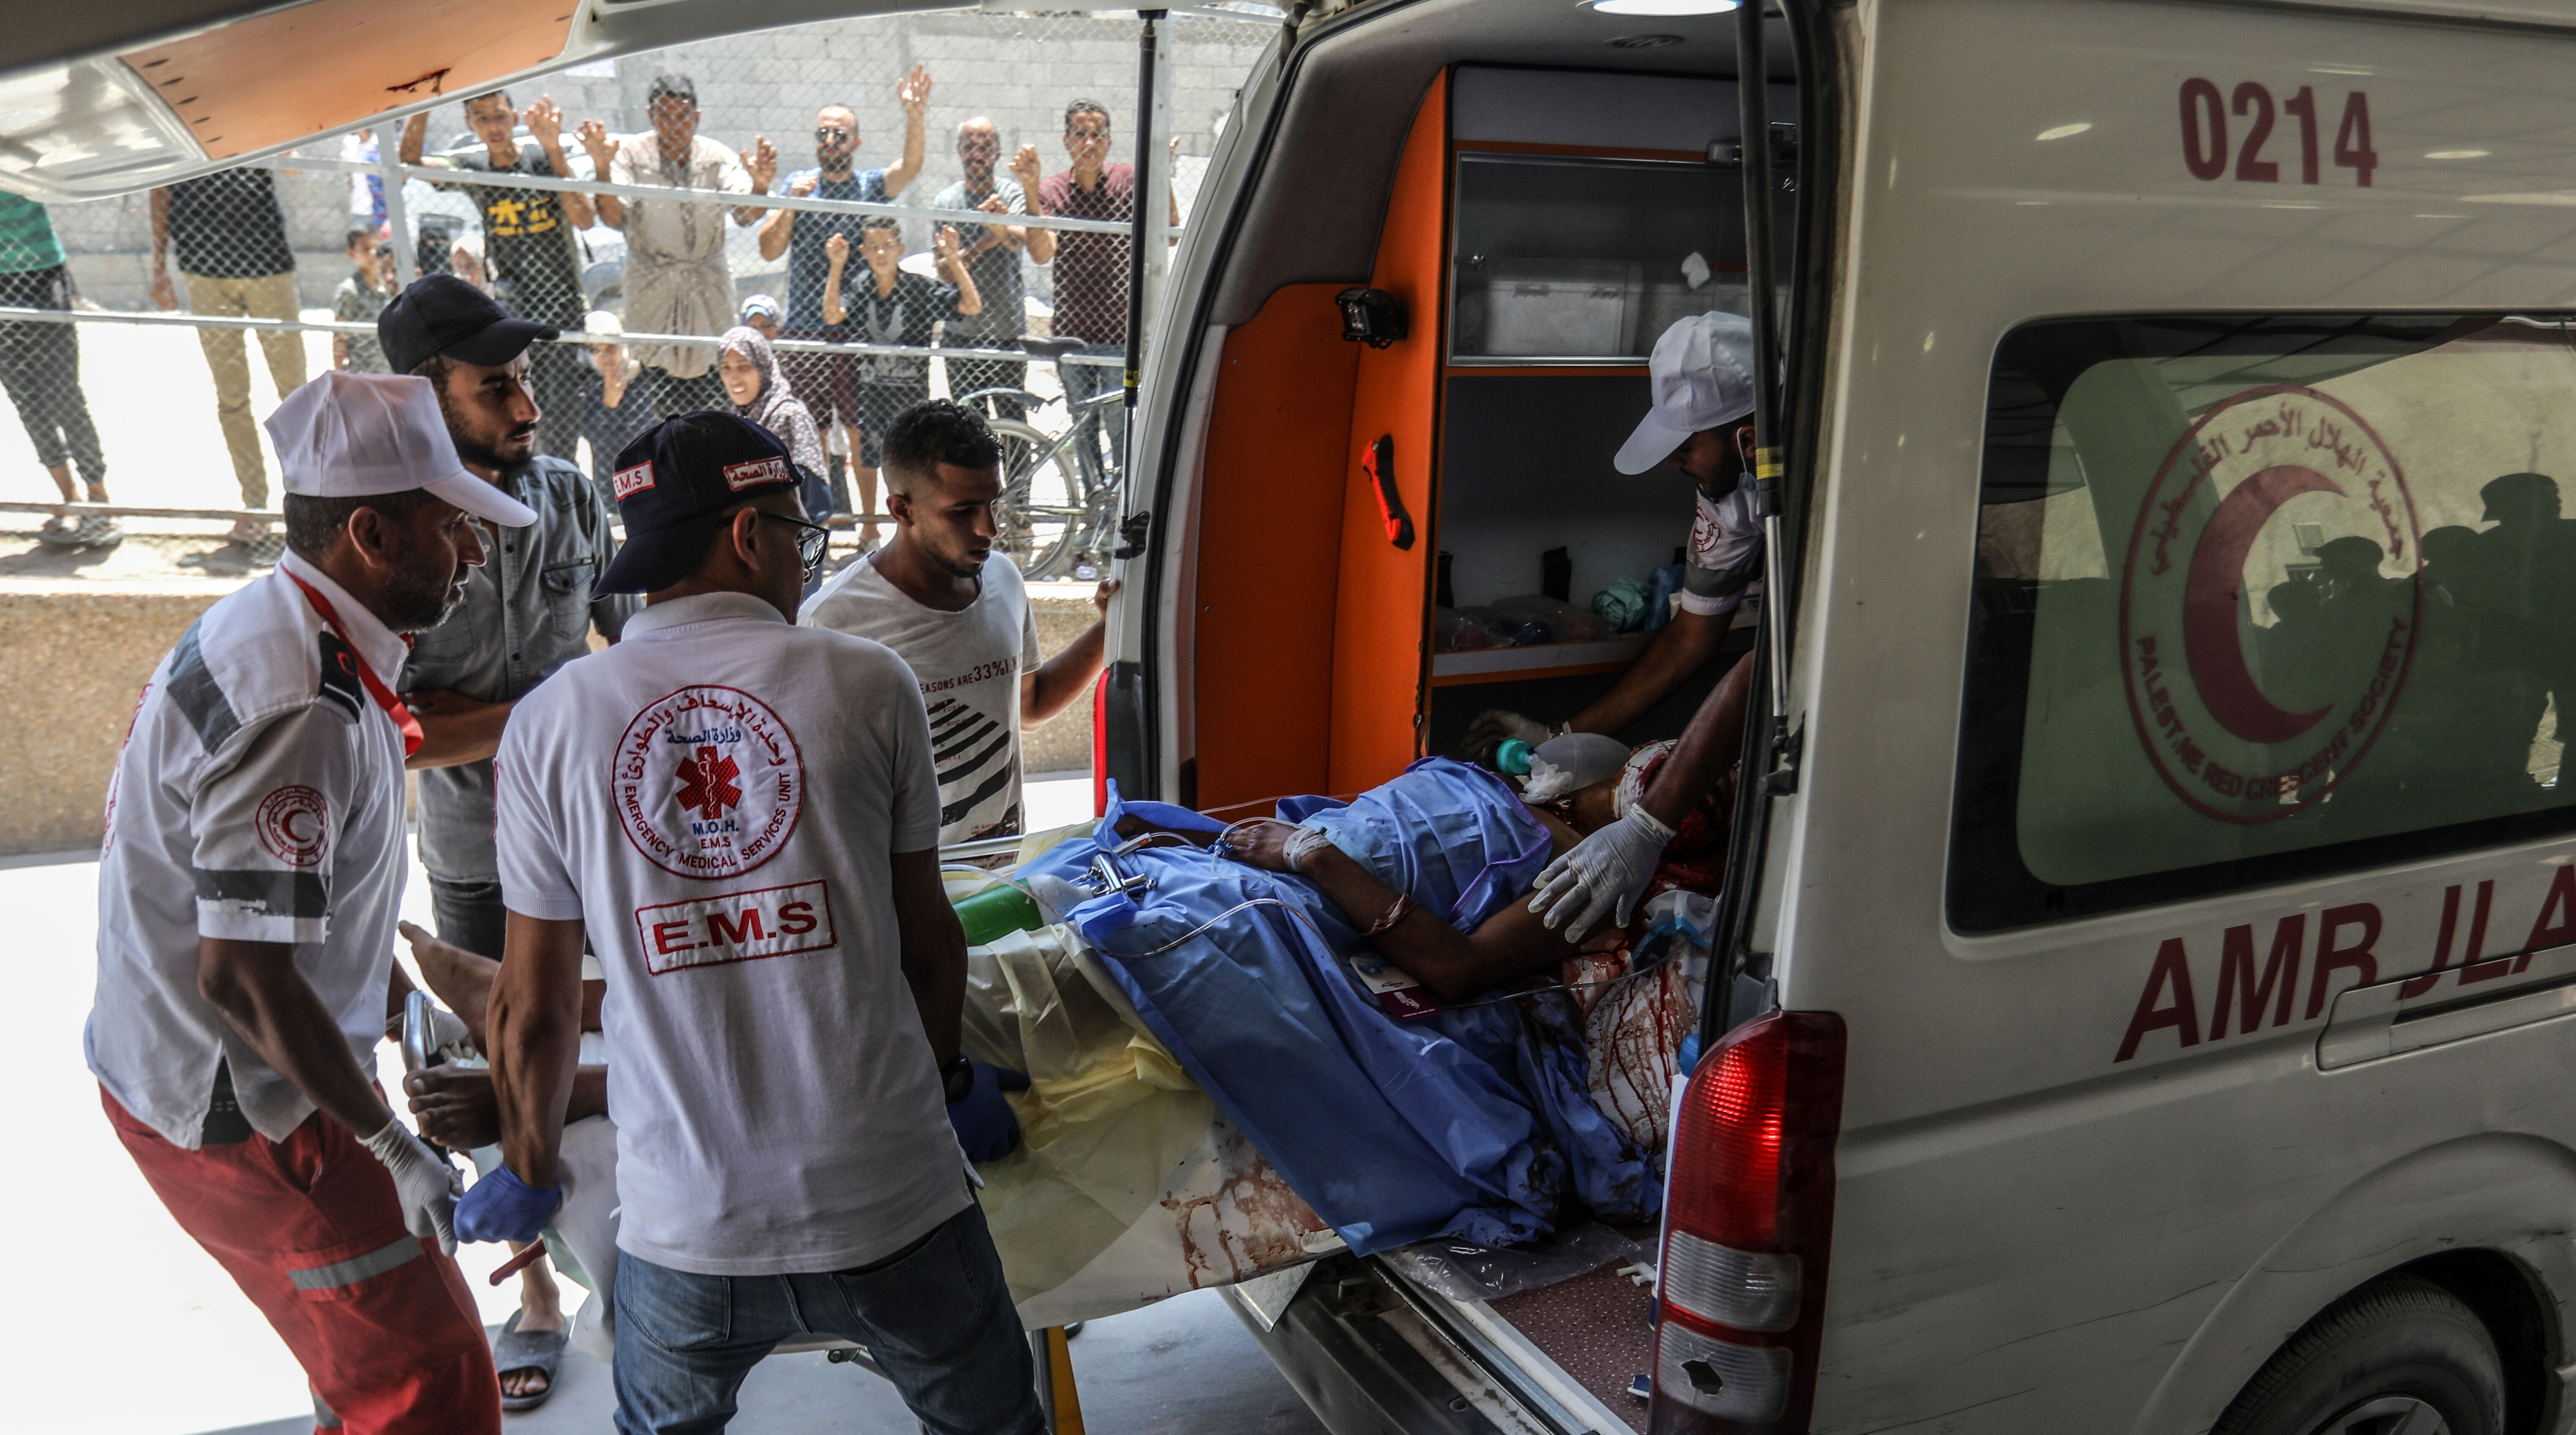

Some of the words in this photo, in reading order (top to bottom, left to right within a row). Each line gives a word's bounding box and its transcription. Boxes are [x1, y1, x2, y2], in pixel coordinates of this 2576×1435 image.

[2179, 77, 2378, 187] 0214
[2305, 416, 2367, 475] الهلال
[957, 673, 973, 687] ARE
[2137, 636, 2205, 775] PALESTNE
[2203, 762, 2243, 797] RED
[2247, 728, 2349, 800] CRESCENT
[2350, 616, 2408, 733] SOCIETY
[665, 728, 711, 745] الصحة
[711, 726, 741, 744] وزارة
[752, 718, 787, 766] وحدة
[624, 786, 675, 858] EMERGENCY
[678, 852, 737, 869] MEDICAL
[741, 808, 787, 860] SERVICES
[778, 772, 791, 802] UNIT
[692, 820, 739, 836] M.O.H.
[700, 836, 731, 850] E.M.S
[652, 901, 818, 955] E.M.S
